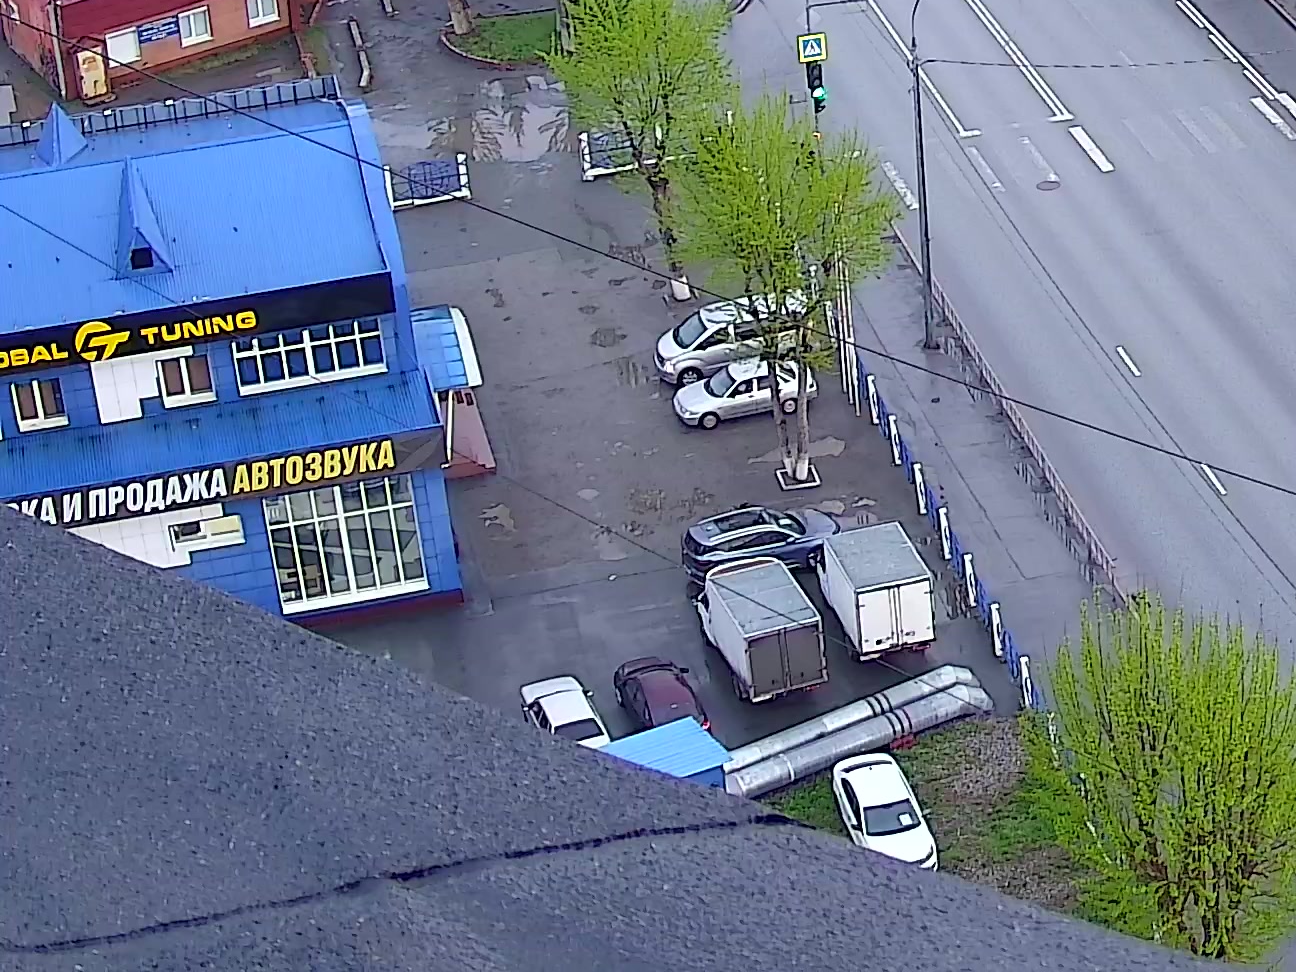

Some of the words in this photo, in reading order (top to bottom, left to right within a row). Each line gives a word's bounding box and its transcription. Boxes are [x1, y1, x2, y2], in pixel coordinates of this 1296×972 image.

[140, 310, 257, 345] TUNING
[62, 492, 82, 524] И
[88, 467, 228, 520] ПРОДАЖА
[232, 440, 395, 496] АВТОЗВУКА
